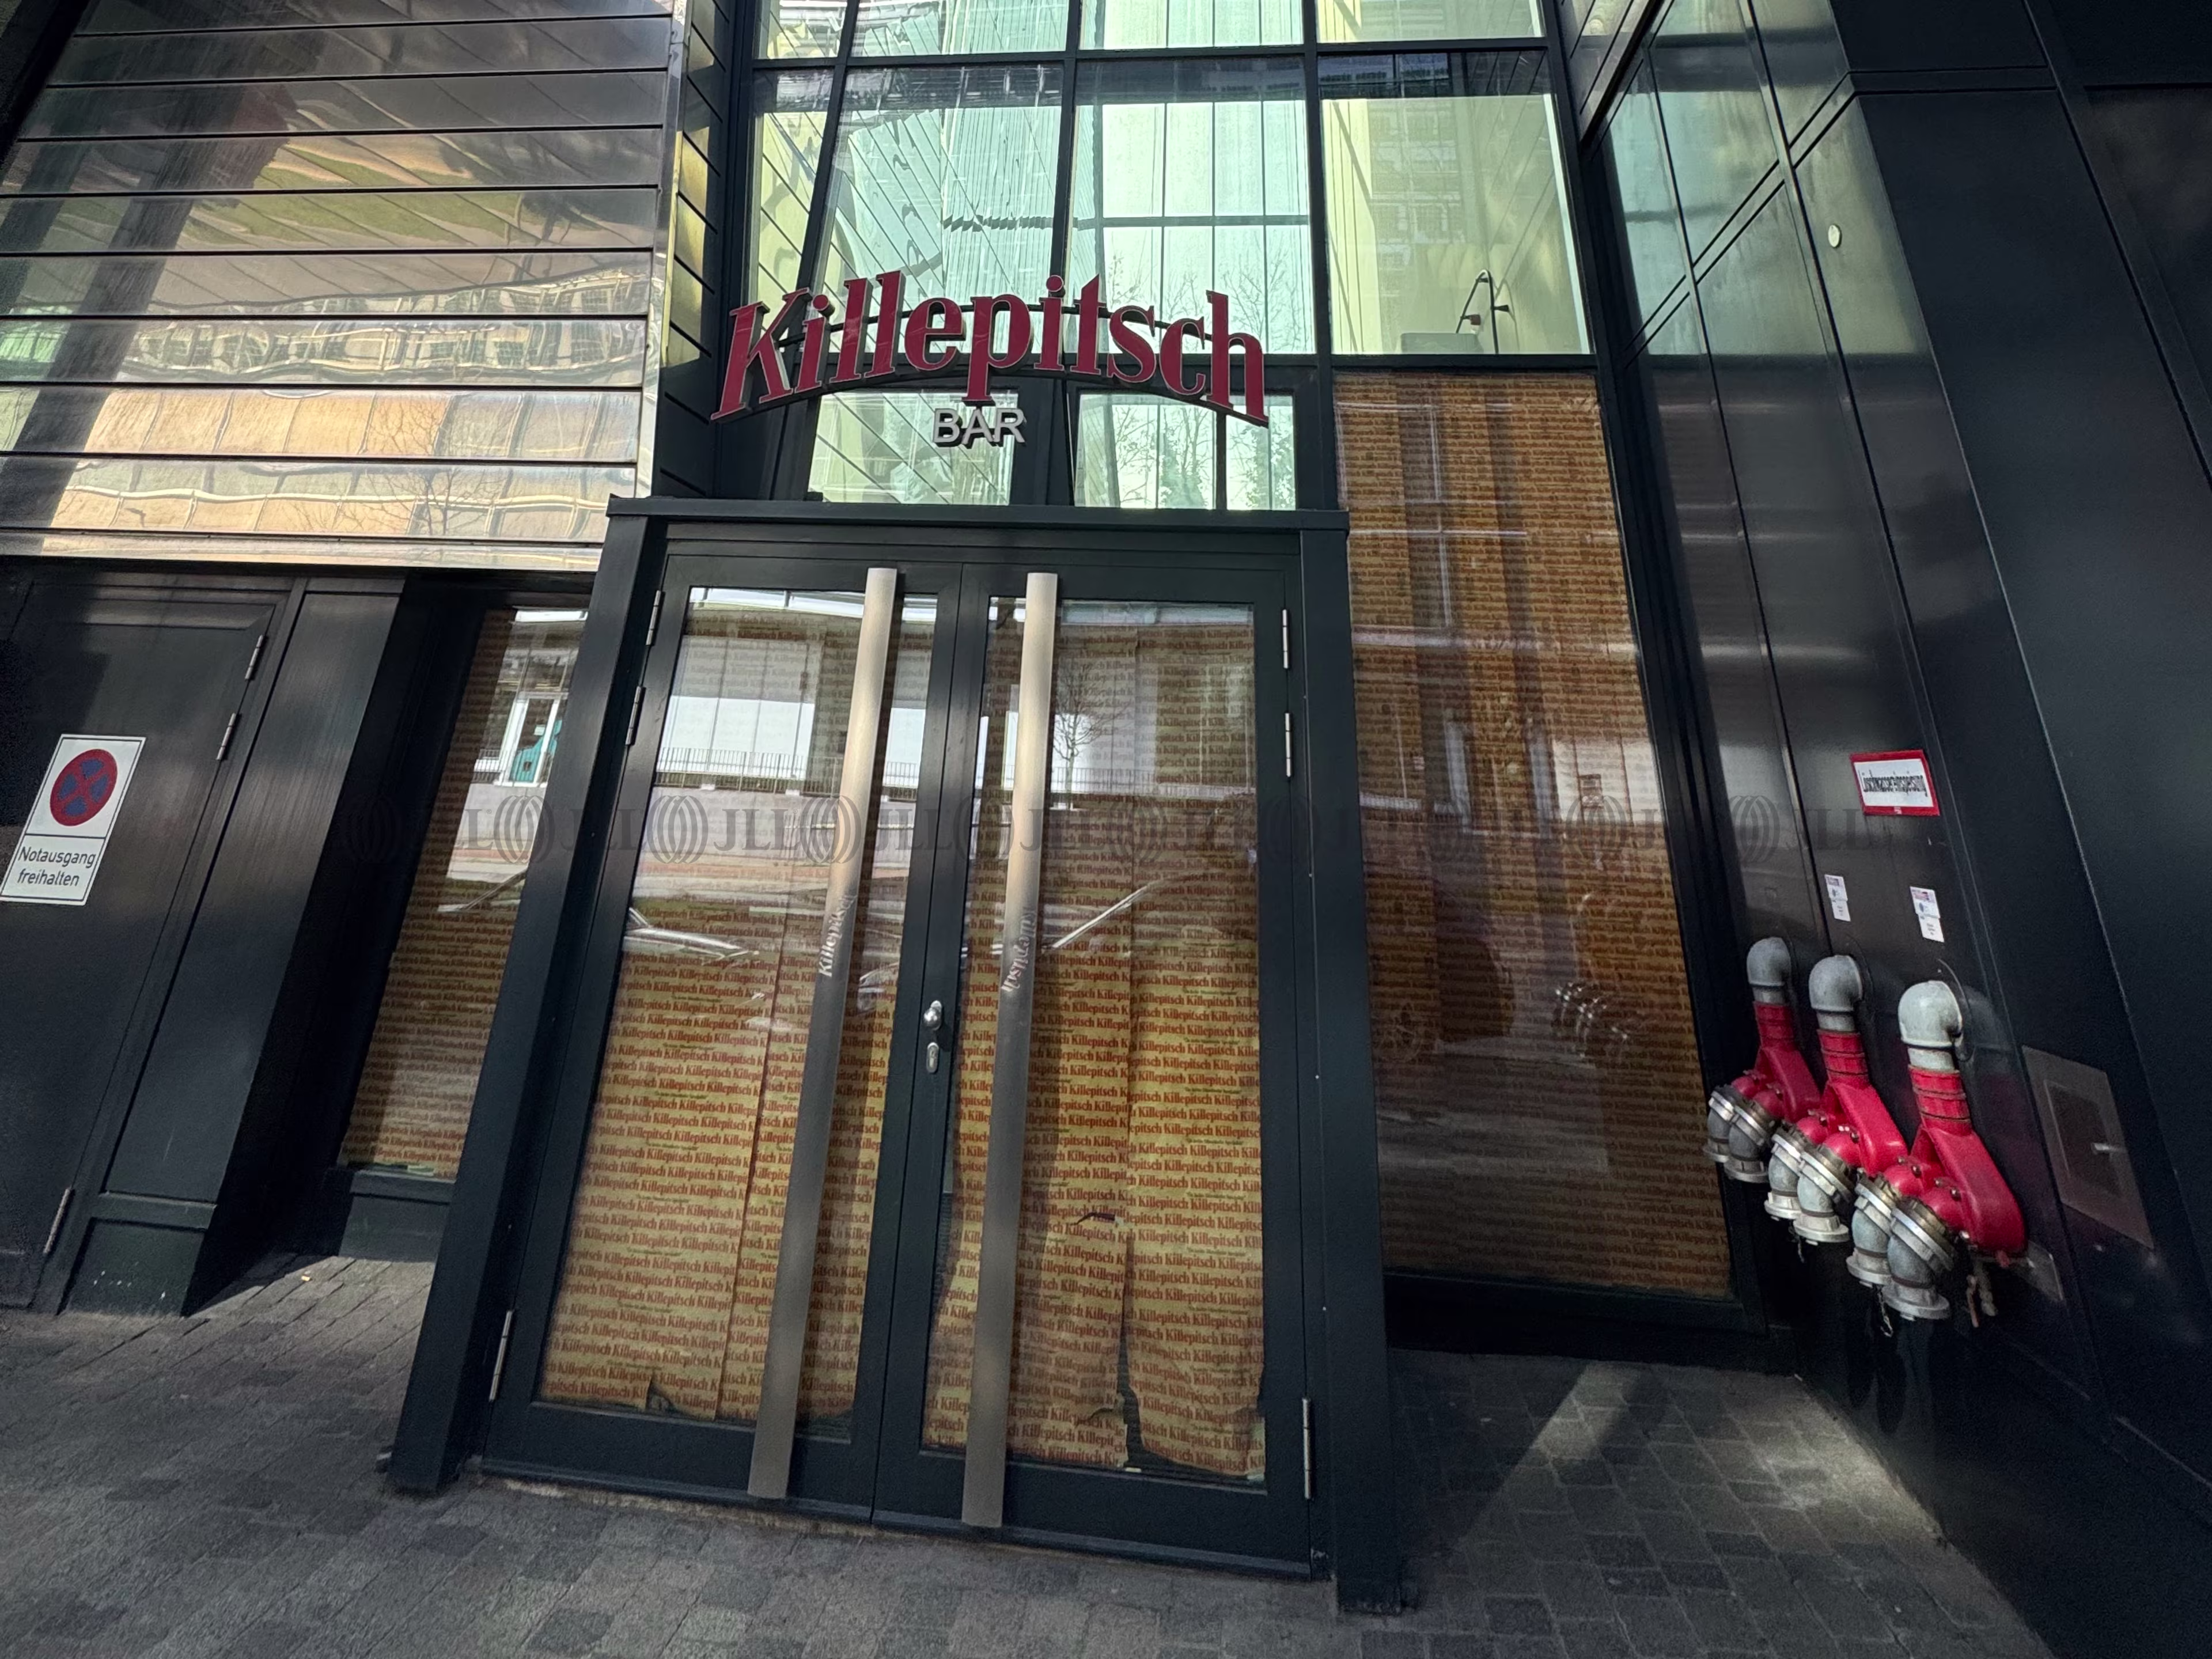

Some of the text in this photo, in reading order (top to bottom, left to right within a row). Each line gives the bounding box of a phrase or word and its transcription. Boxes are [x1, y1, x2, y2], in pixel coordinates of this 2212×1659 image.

[710, 270, 1269, 427] Killepitsch
[933, 408, 1025, 445] BAR
[18, 846, 96, 869] Notausgang
[17, 869, 79, 887] freihalten
[633, 966, 768, 986] Killepitsch Killepitsch Killepitsch
[1073, 969, 1119, 982] Killepitsch
[1186, 962, 1233, 974] Killepitsch
[653, 982, 743, 998] Killepitsch Killepitsch
[1162, 976, 1257, 990] Killepitsch Killepitsch
[1073, 1002, 1119, 1015] Killepitsch
[1140, 993, 1233, 1008] Killepitsch Killepitsch
[718, 1005, 763, 1018] Killepitsch
[1162, 1009, 1209, 1022] Killepitsch
[647, 1014, 738, 1031] Killepitsch Killepitsch
[1139, 1022, 1234, 1037] Killepitsch Killepitsch
[622, 1027, 665, 1041] Killepitsch
[668, 1030, 713, 1043] Killepitsch
[714, 1033, 759, 1047] Killepitsch
[1072, 1035, 1118, 1048] Killepitsch
[1139, 1041, 1185, 1054] Killepitsch
[618, 1046, 662, 1059] Killepitsch
[711, 1052, 755, 1067] Killepitsch
[1162, 1057, 1211, 1071] Killepitsch
[638, 1062, 731, 1080] Killepitsch Killepitsch
[1070, 1065, 1118, 1079] Killepitsch
[1139, 1071, 1236, 1087] Killepitsch Killepitsch
[612, 1075, 657, 1088] Killepitsch
[659, 1078, 704, 1092] Killepitsch
[707, 1082, 752, 1096] Killepitsch
[1069, 1084, 1118, 1098] Killepitsch
[679, 1101, 726, 1113] Killepitsch
[1163, 1093, 1213, 1106] Killepitsch
[606, 1109, 747, 1132] Killepitsch Killepitsch Killepitsch
[1069, 1115, 1117, 1128] Killepitsch
[1138, 1107, 1238, 1123] Killepitsch Killepitsch
[626, 1126, 721, 1145] Killepitsch Killepitsch
[1164, 1124, 1213, 1137] Killepitsch
[600, 1145, 645, 1158] Killepitsch
[694, 1153, 742, 1167] Killepitsch
[1067, 1150, 1116, 1164] Killepitsch
[1138, 1143, 1239, 1159] Killepitsch Killepitsch
[620, 1163, 715, 1182] Killepitsch Killepitsch
[1164, 1161, 1214, 1174] Killepitsch
[593, 1177, 638, 1190] Killepitsch
[640, 1181, 688, 1195] Killepitsch
[690, 1185, 737, 1199] Killepitsch
[1138, 1175, 1240, 1192] Killepitsch Killepitsch
[1066, 1188, 1115, 1202] Killepitsch
[1138, 1197, 1188, 1210] Killepitsch
[686, 1205, 734, 1219] Killepitsch
[611, 1215, 707, 1235] Killepitsch Killepitsch
[1164, 1214, 1216, 1229] Killepitsch
[584, 1228, 630, 1245] Killepitsch
[631, 1233, 679, 1249] Killepitsch
[681, 1238, 729, 1252] Killepitsch
[1138, 1230, 1243, 1248] Killepitsch Killepitsch
[652, 1258, 700, 1274] Killepitsch
[1164, 1254, 1217, 1270] Killepitsch
[624, 1272, 672, 1287] Killepitsch
[675, 1276, 723, 1294] Killepitsch
[1138, 1270, 1244, 1289] Killepitsch Killepitsch
[646, 1291, 696, 1308] Killepitsch
[1165, 1289, 1217, 1305] Killepitsch
[667, 1316, 718, 1332] Killepitsch
[1138, 1310, 1191, 1325] Killepitsch
[1166, 1330, 1218, 1346] Killepitsch
[579, 1382, 630, 1399] Killepitsch
